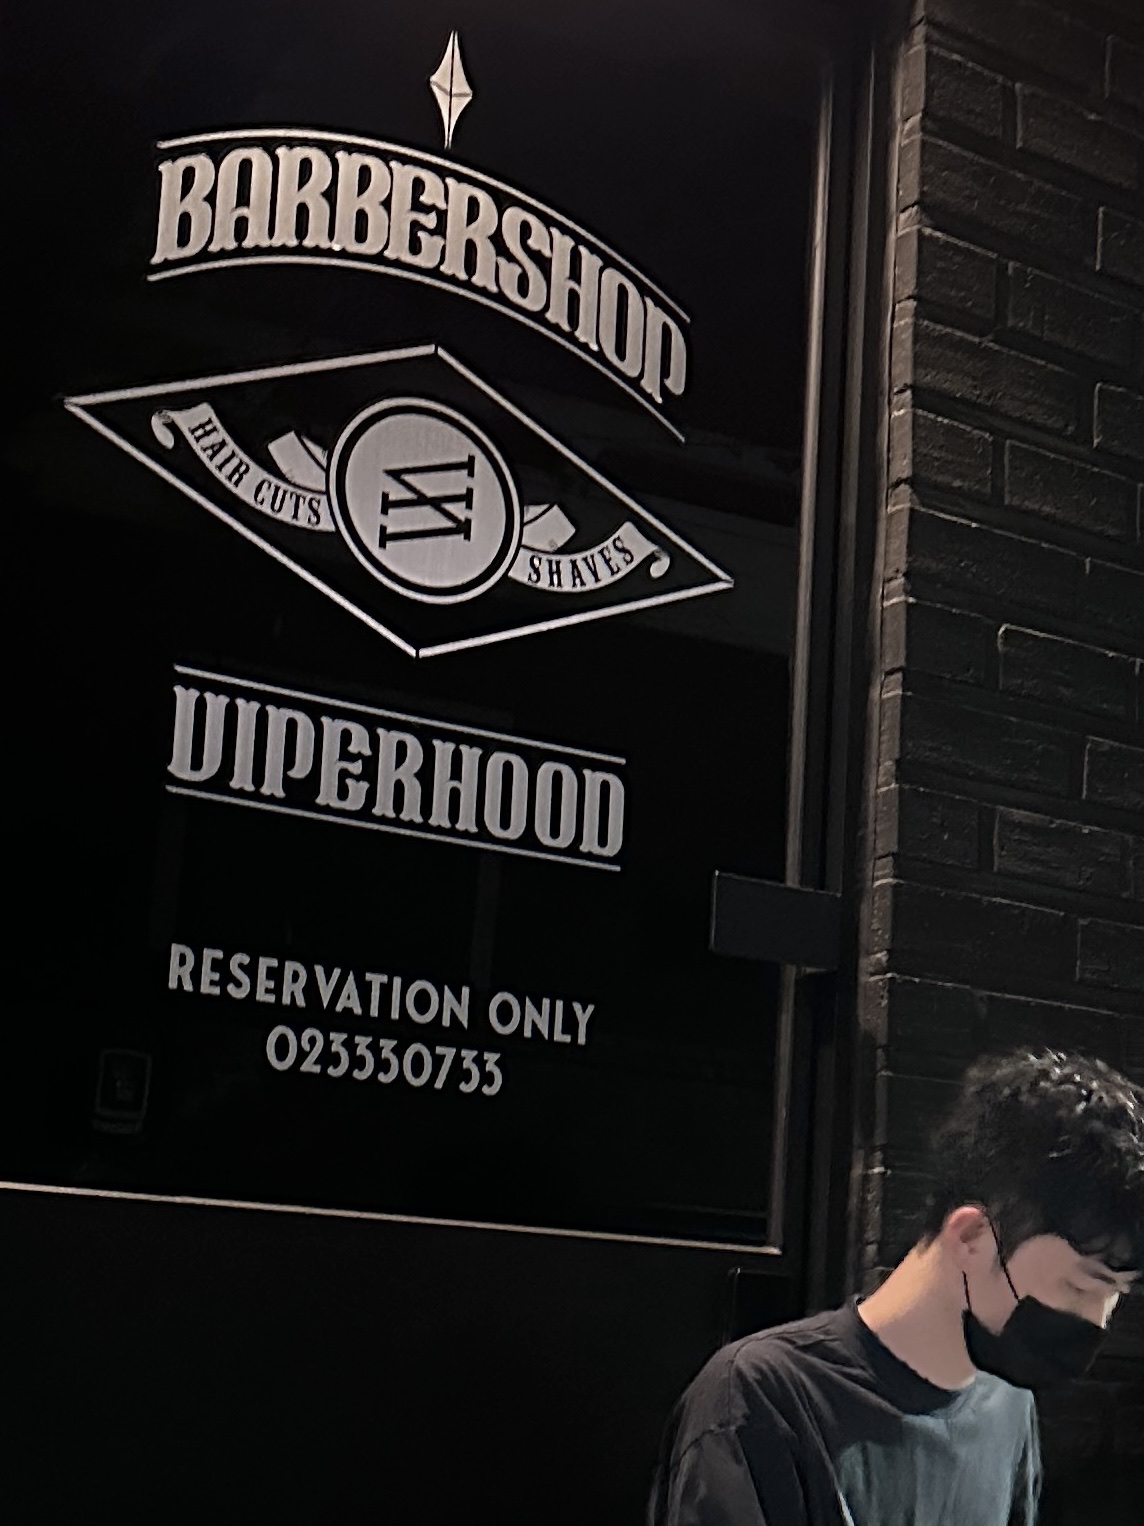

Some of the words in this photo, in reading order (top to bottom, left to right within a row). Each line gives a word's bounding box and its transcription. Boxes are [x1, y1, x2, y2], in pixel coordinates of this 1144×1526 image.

[149, 145, 688, 404] BARBERSHOP
[188, 416, 251, 489] HAIR
[253, 478, 322, 528] CUTS
[527, 534, 635, 589] SHAVES
[165, 683, 627, 859] VIPERHOOD
[168, 942, 471, 1031] RESERVATION
[487, 990, 596, 1047] ONLY
[265, 1024, 504, 1097] 023330733
